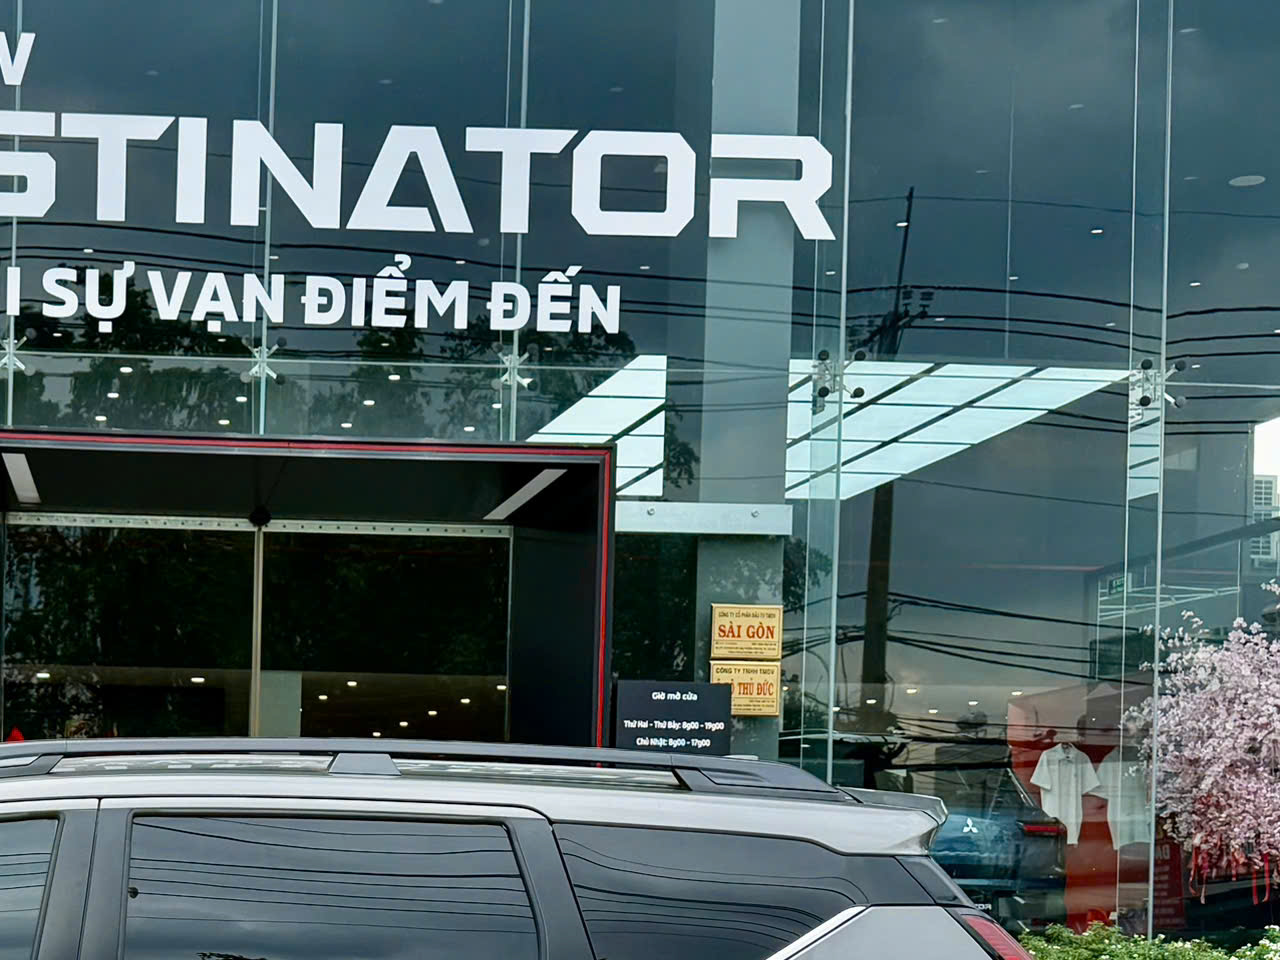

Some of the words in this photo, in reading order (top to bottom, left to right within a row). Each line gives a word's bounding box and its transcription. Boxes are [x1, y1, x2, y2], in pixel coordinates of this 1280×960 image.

[42, 260, 135, 332] SỰ
[148, 271, 284, 332] VẠN
[301, 254, 469, 329] ĐIỂM
[486, 265, 622, 335] ĐẾN
[718, 621, 742, 639] SÀI
[746, 622, 775, 640] GÒN
[738, 677, 755, 696] THỦ
[756, 679, 774, 696] ĐỨC
